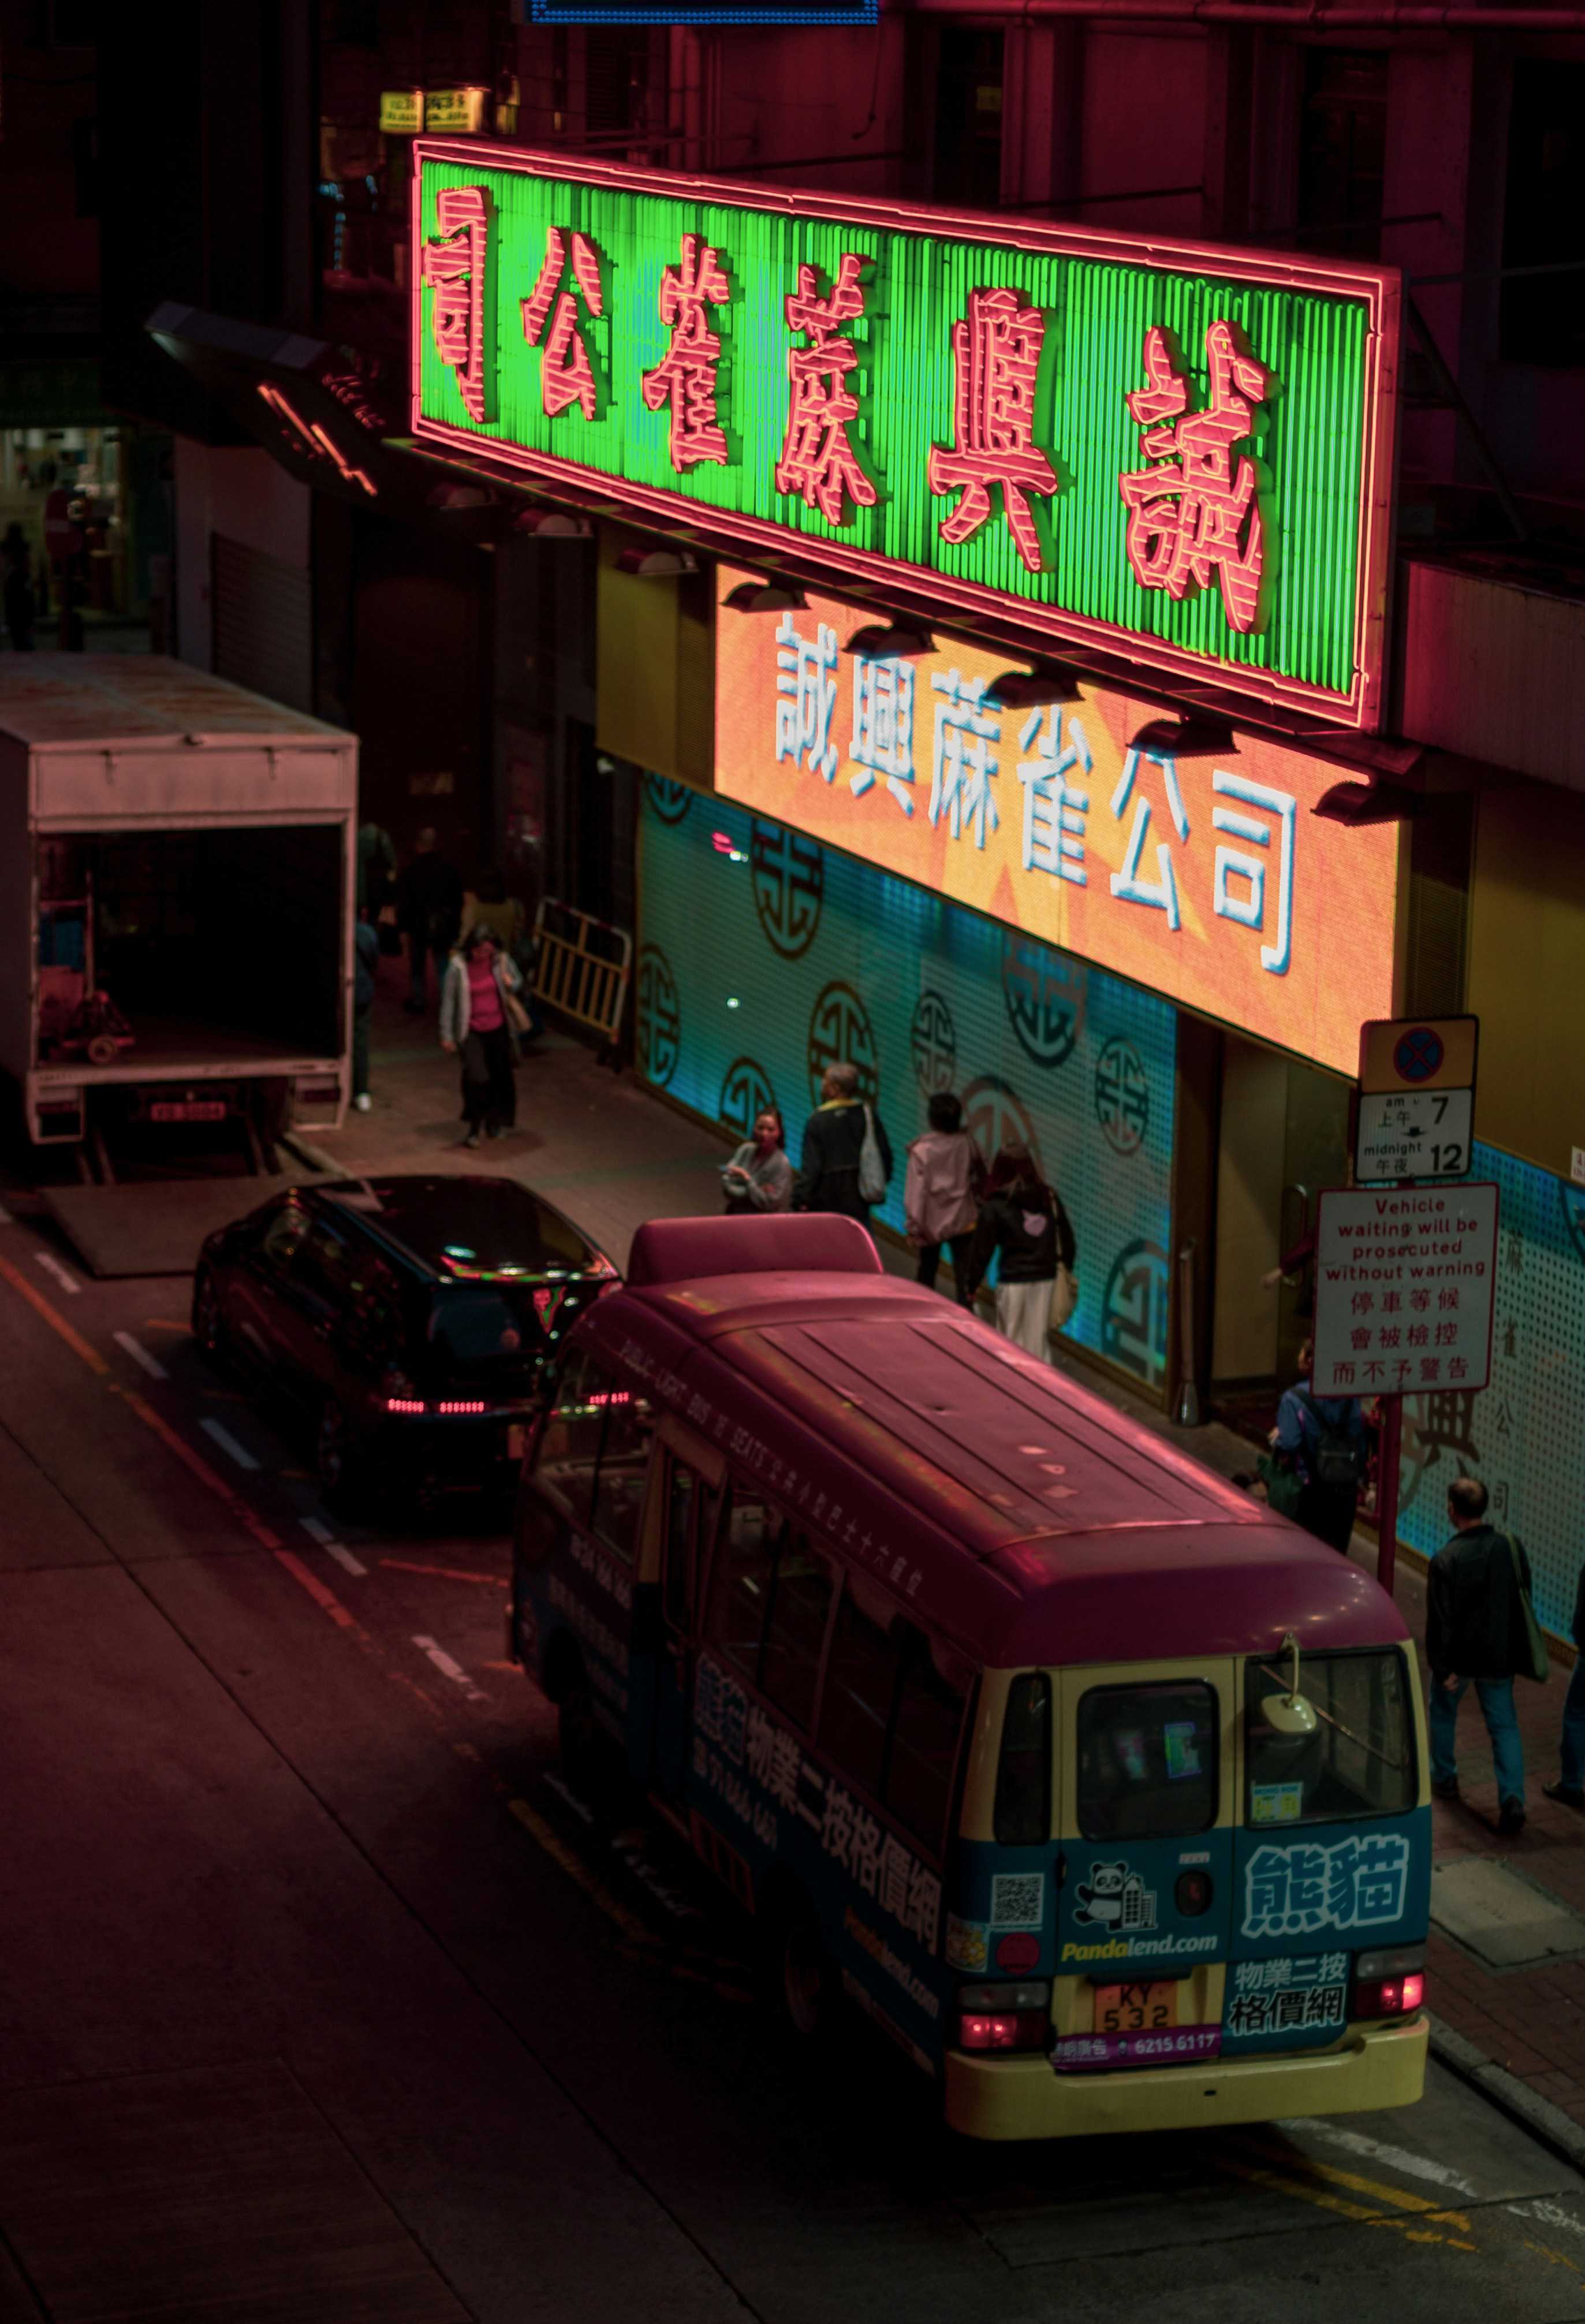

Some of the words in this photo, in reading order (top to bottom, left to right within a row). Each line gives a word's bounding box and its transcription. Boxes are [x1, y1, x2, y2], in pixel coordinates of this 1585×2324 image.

[1386, 1097, 1404, 1108] am
[1431, 1097, 1449, 1124] 7
[1378, 1111, 1410, 1128] 上午
[1364, 1142, 1422, 1156] midnight
[1431, 1144, 1462, 1171] 12
[1376, 1158, 1408, 1175] 午夜
[1375, 1198, 1445, 1215] Vehicle
[1338, 1221, 1412, 1238] waiting
[1418, 1218, 1450, 1235] will
[1457, 1217, 1478, 1232] be
[1353, 1239, 1462, 1261] prosecuted
[1326, 1265, 1403, 1281] without
[1410, 1261, 1485, 1276] warning
[1351, 1287, 1460, 1316] 停車等候
[1351, 1321, 1458, 1351] 會被檢控
[1333, 1355, 1469, 1384] 而不予警告
[1240, 1834, 1410, 1939] 熊貓
[1061, 1933, 1218, 1963] Pandalend.com
[1235, 1952, 1348, 1991] 物業二按
[1120, 1984, 1153, 2007] KY
[1104, 2005, 1168, 2031] 532
[1229, 1984, 1347, 2036] 格價網
[1133, 2036, 1173, 2054] 6215
[1176, 2031, 1217, 2049] 6117
